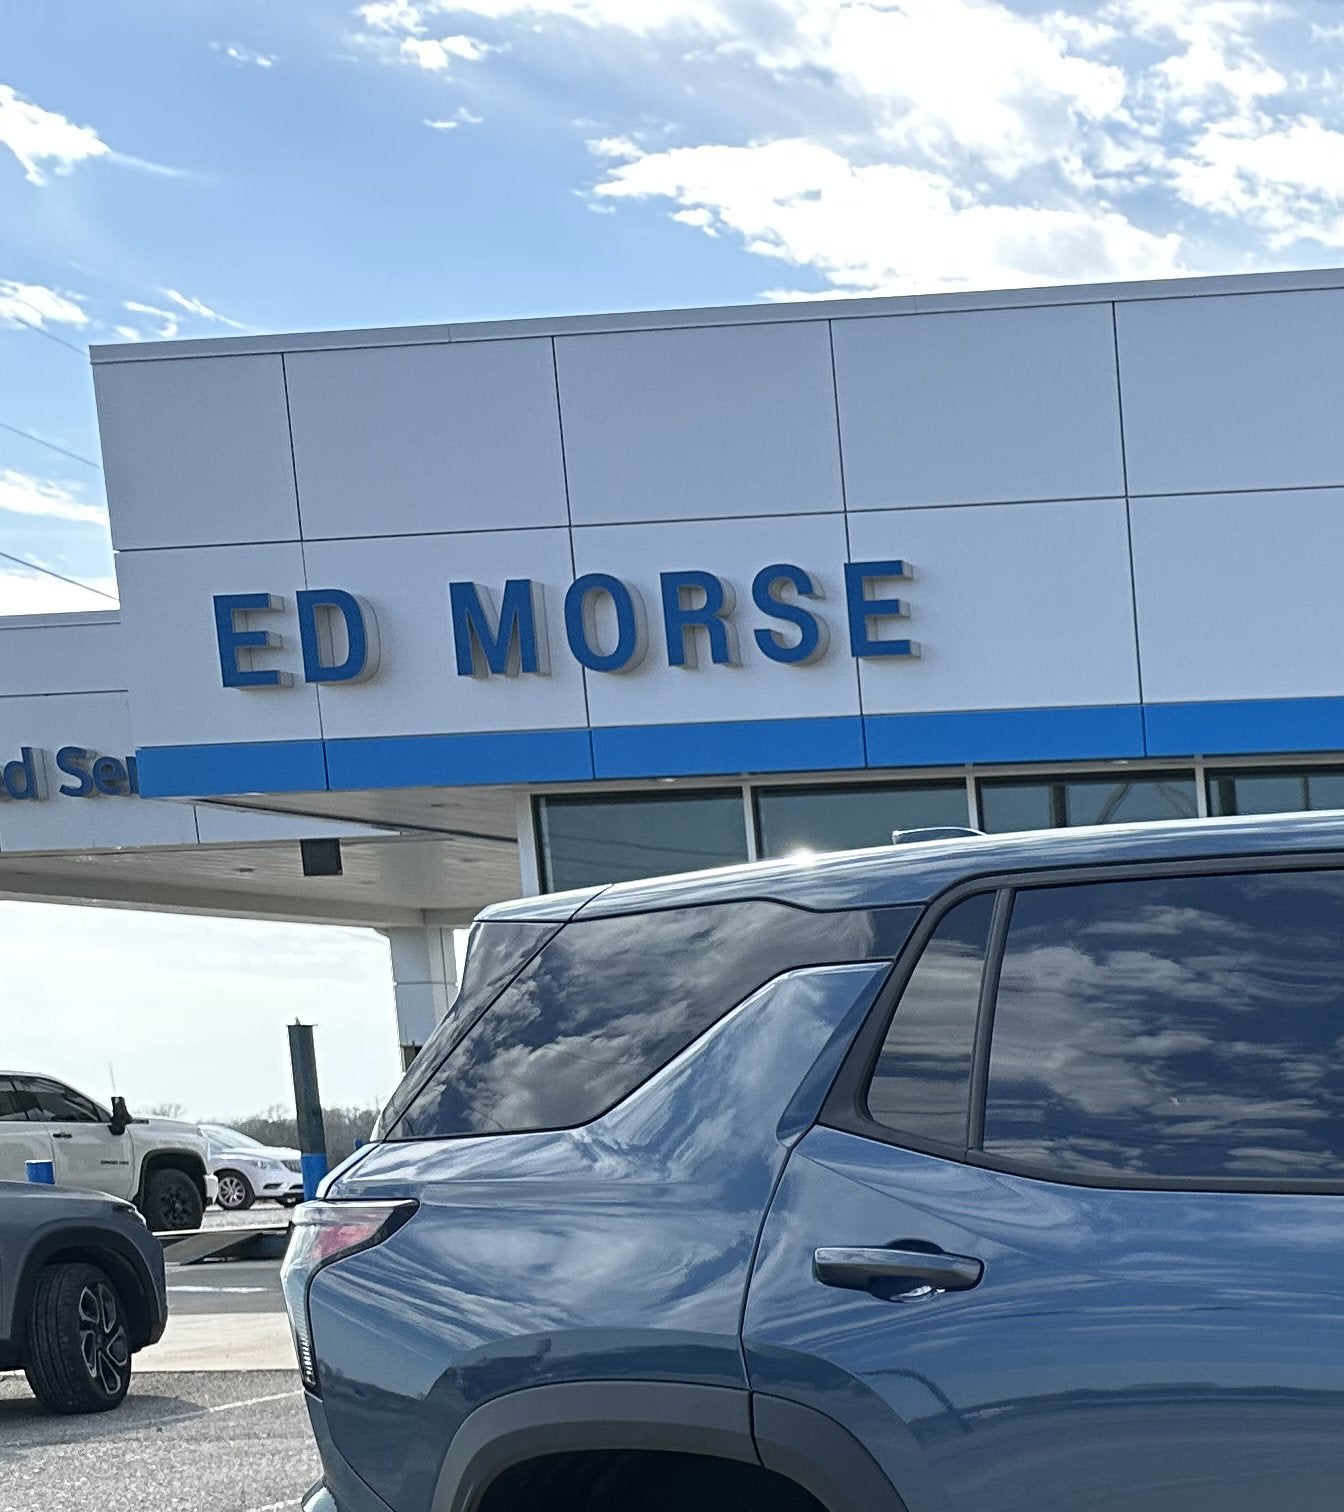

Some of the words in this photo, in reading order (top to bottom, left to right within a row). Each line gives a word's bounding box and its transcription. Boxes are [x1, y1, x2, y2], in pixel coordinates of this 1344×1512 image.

[213, 588, 378, 689] ED
[448, 560, 921, 678] MORSE
[0, 746, 38, 800] d
